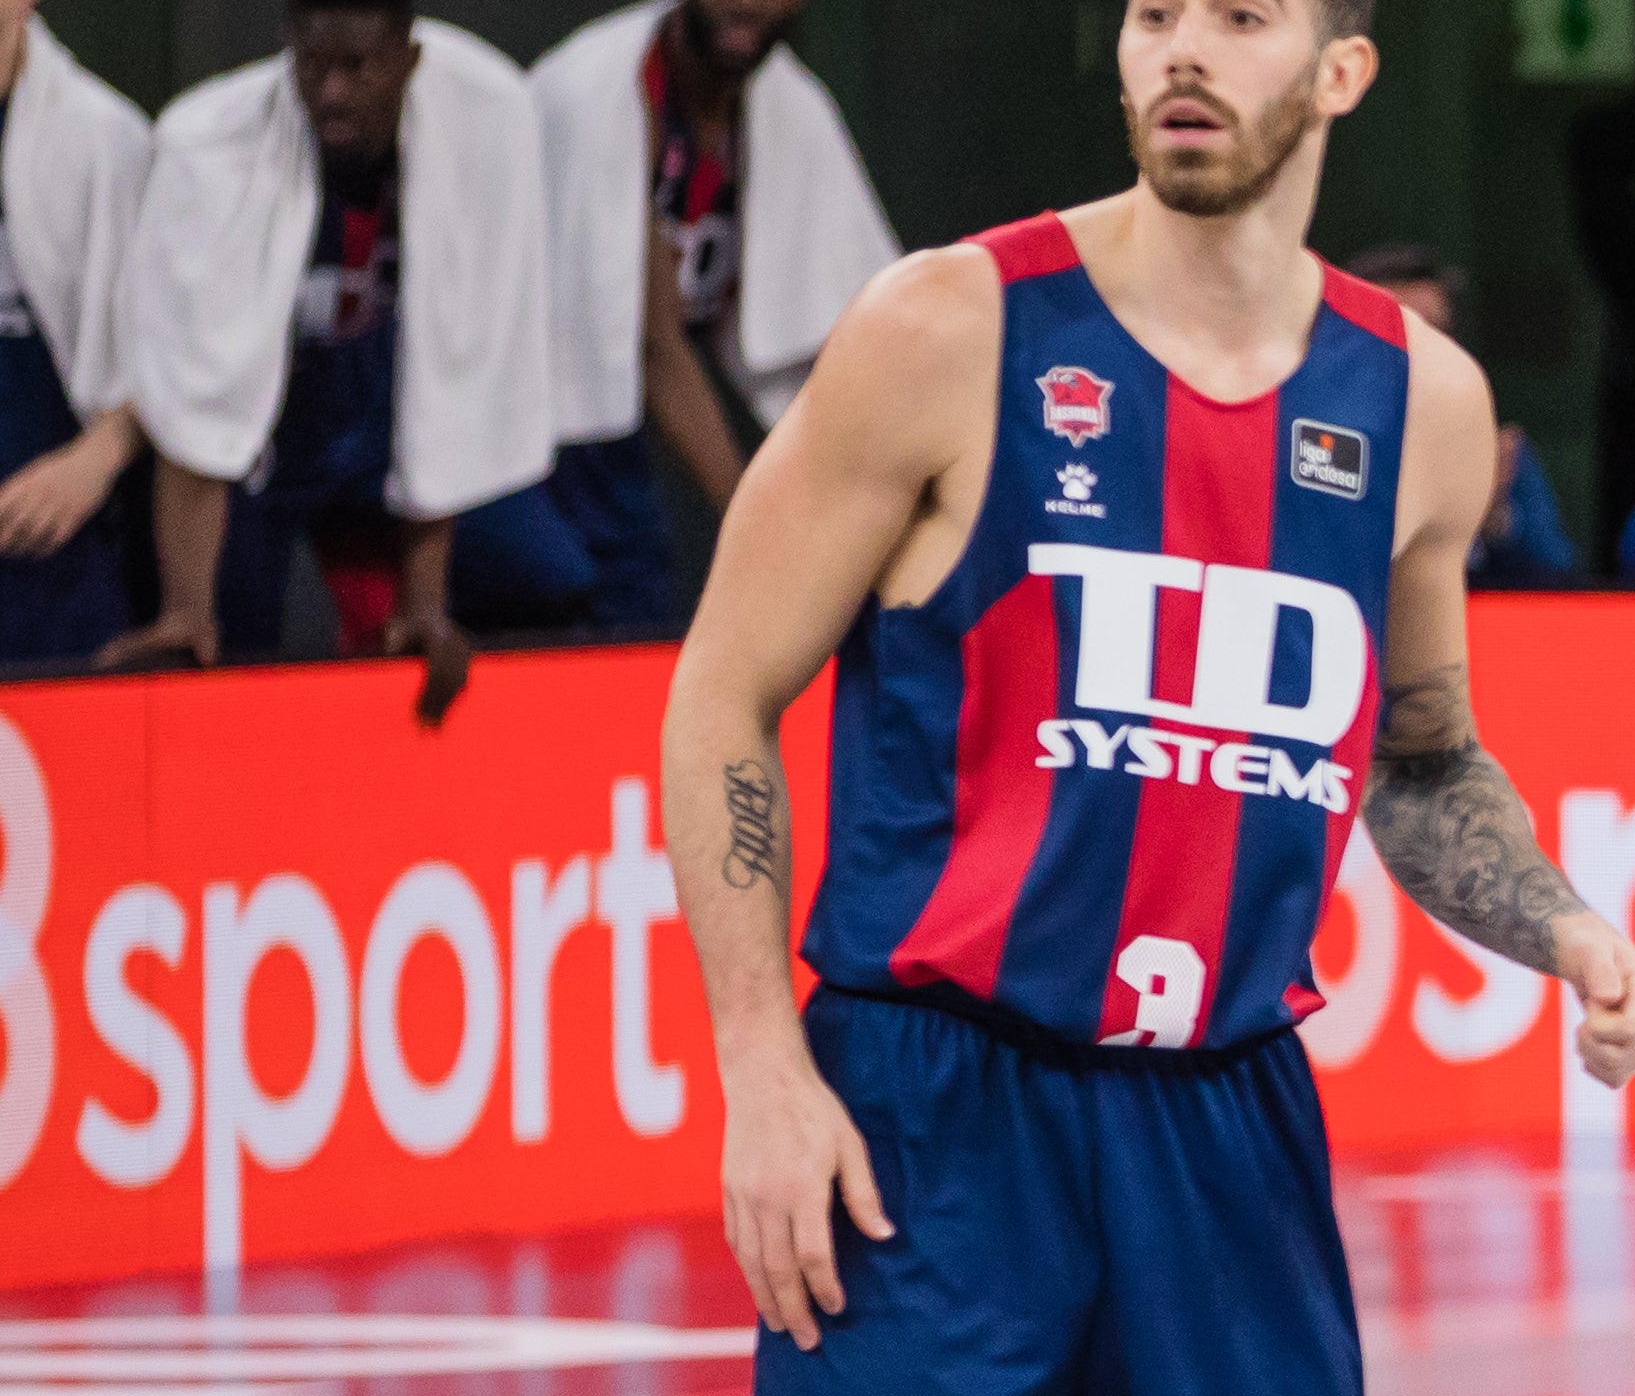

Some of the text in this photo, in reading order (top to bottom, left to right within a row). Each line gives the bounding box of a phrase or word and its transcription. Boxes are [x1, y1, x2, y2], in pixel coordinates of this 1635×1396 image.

[1299, 440, 1332, 465] liga
[1298, 461, 1359, 490] endesa
[1044, 499, 1107, 519] KELME
[1028, 543, 1367, 747] TD
[1035, 719, 1352, 815] SYSTEMS
